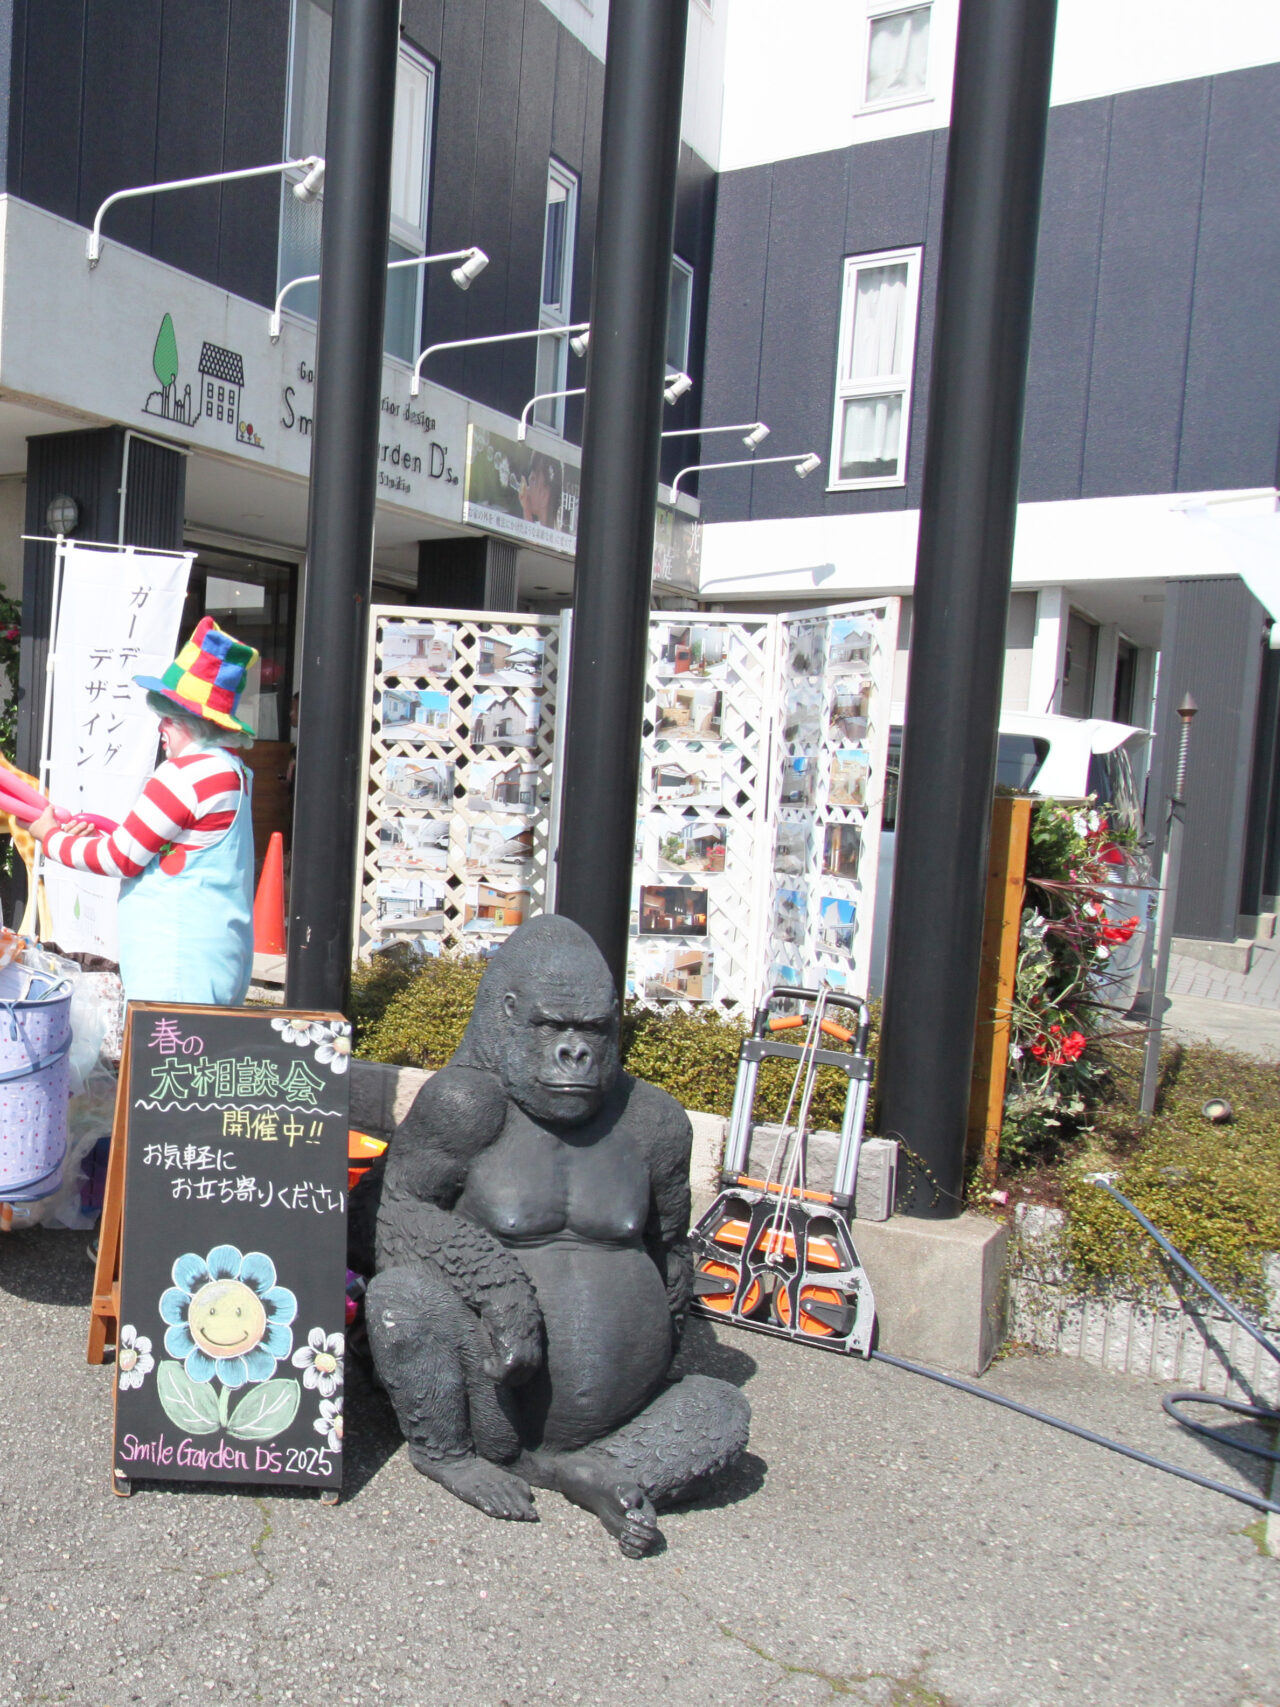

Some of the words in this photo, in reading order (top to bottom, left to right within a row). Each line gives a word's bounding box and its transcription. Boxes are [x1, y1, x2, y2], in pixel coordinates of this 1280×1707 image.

[378, 444, 422, 474] rden
[104, 585, 153, 768] ガーデニング
[148, 1017, 204, 1056] 春の
[149, 1056, 326, 1105] 大相談会
[143, 1142, 237, 1171] お気軽に
[171, 1175, 345, 1214] お立ち寄りください
[120, 1434, 174, 1467] Smile
[176, 1438, 250, 1471] Garden
[255, 1443, 282, 1473] D's
[285, 1446, 333, 1476] 2025
